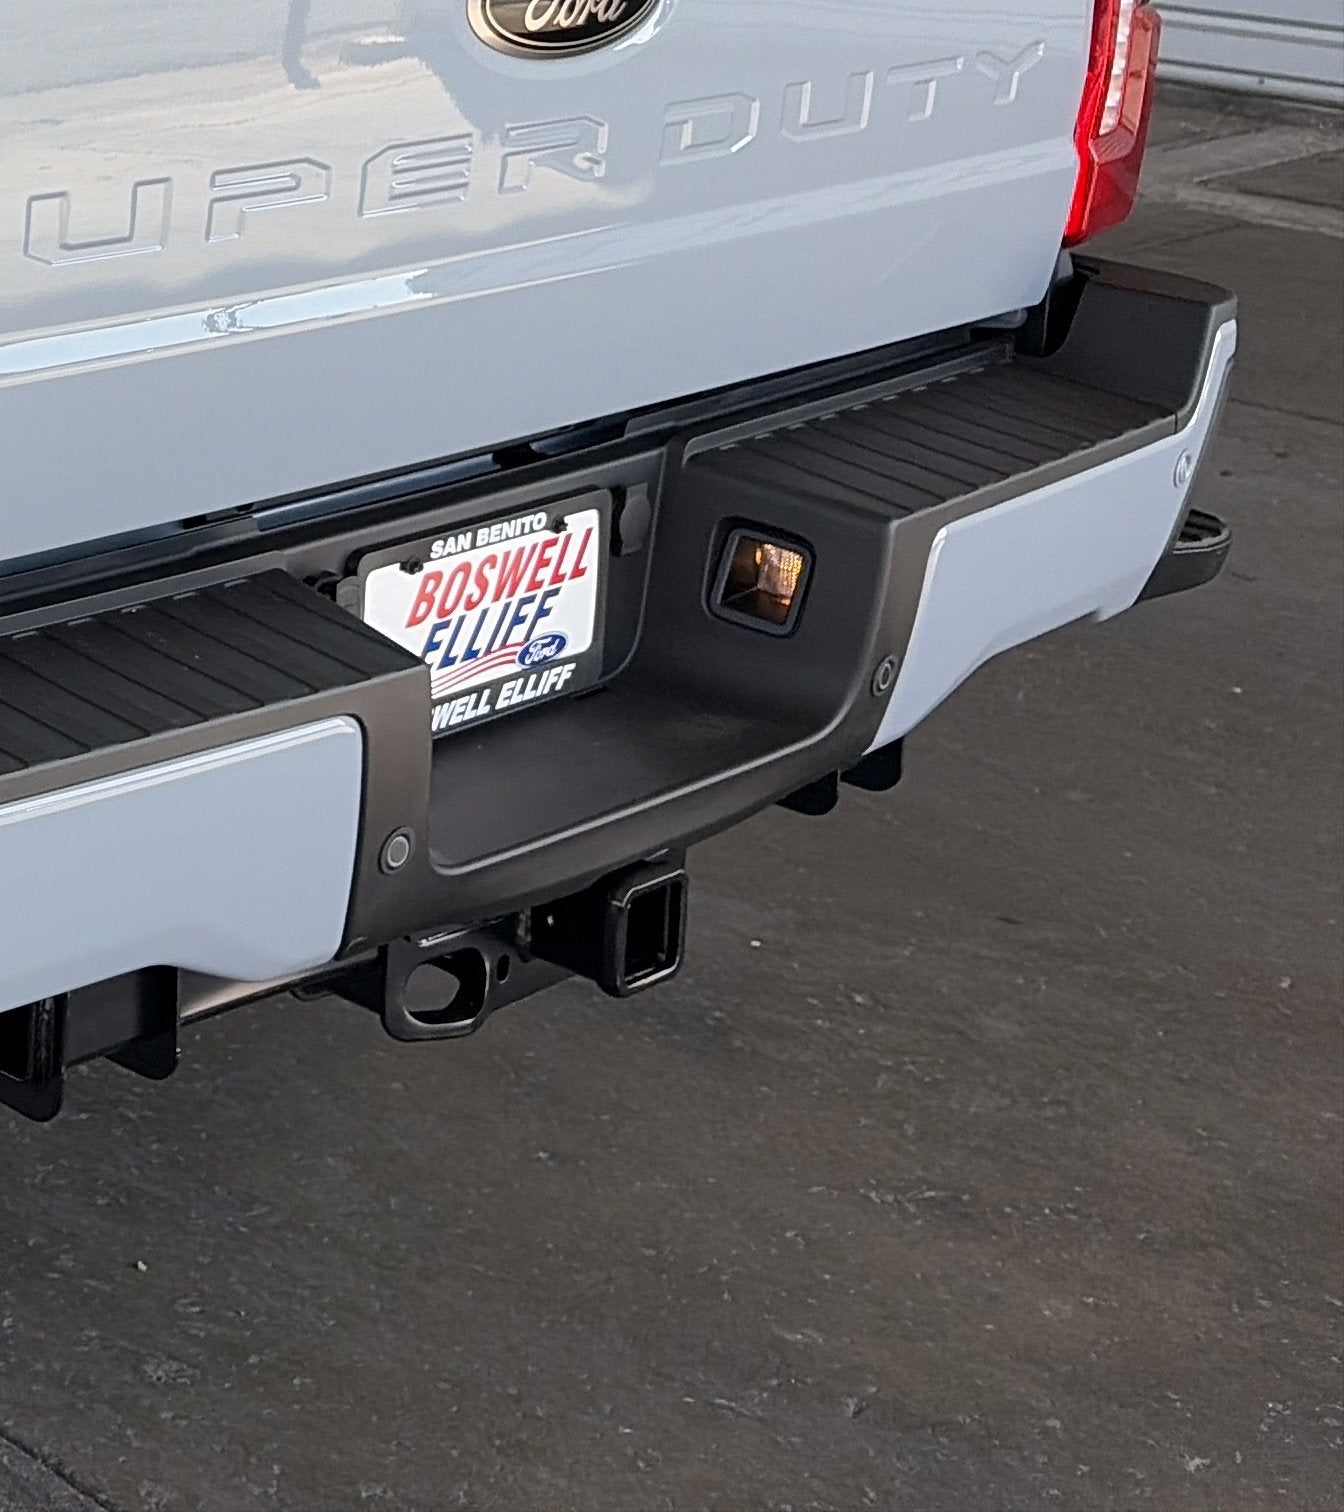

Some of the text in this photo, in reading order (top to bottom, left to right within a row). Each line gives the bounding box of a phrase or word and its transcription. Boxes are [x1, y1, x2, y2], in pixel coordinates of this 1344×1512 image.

[659, 37, 1048, 169] DUTY
[430, 512, 547, 559] SAN BENITO
[405, 527, 593, 629] BOSWELL
[421, 587, 562, 670] ELLIFF
[525, 637, 561, 665] Ford
[495, 663, 576, 711] ELLIFF
